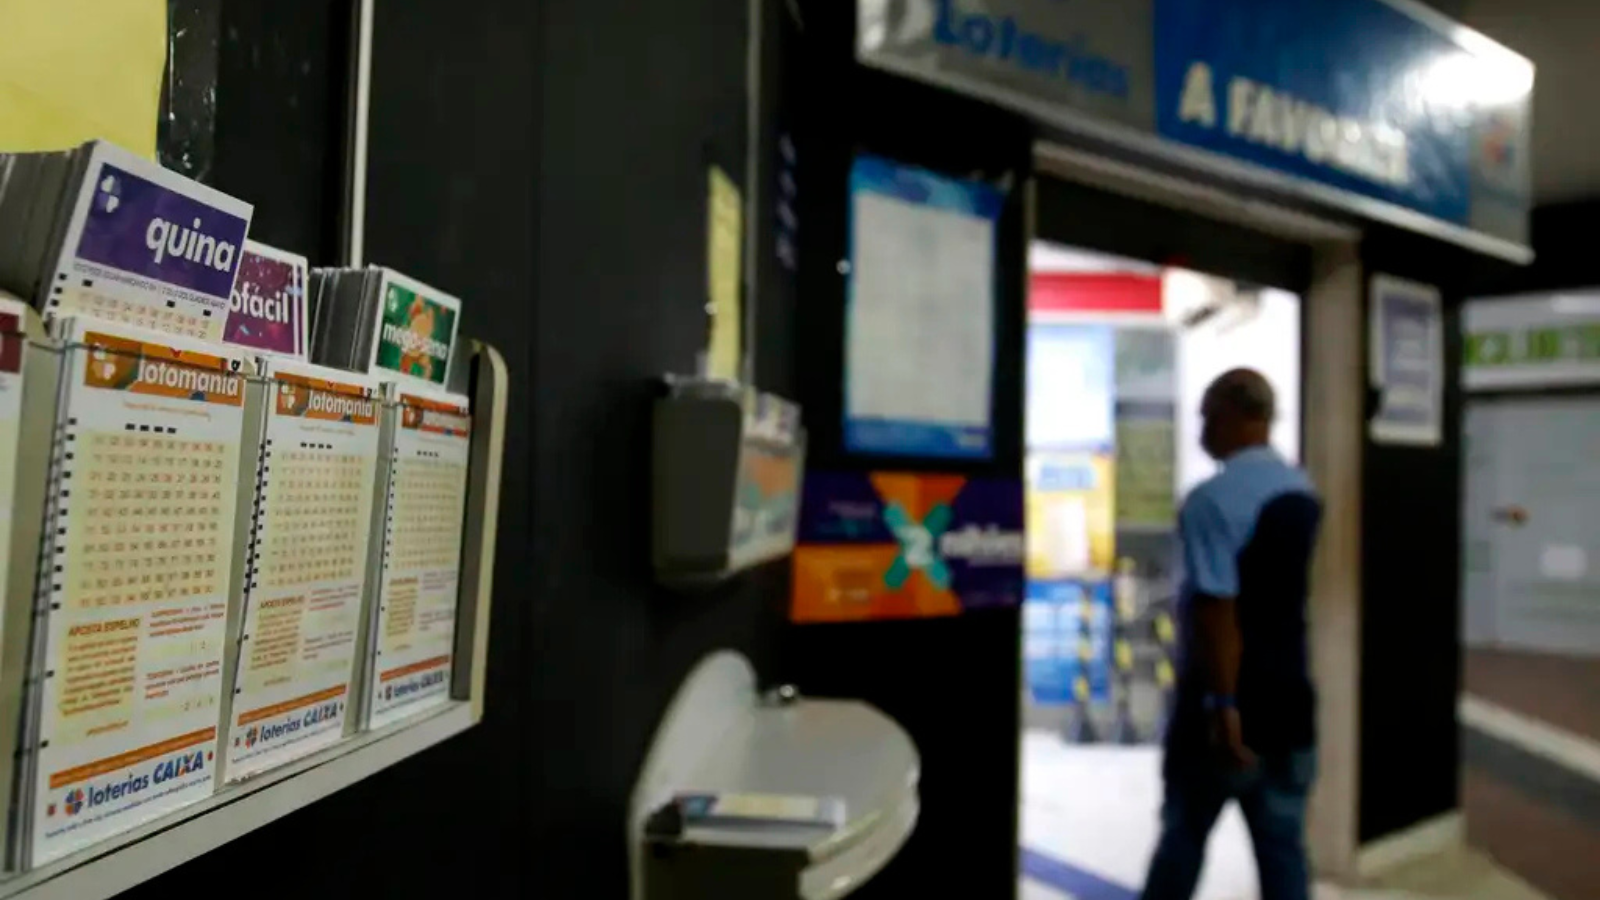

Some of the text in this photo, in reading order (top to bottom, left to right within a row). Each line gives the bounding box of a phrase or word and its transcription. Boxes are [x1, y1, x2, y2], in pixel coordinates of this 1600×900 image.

[1178, 60, 1217, 129] A
[146, 216, 236, 273] quina
[137, 356, 239, 396] lotomania
[308, 388, 373, 417] lotomania
[259, 716, 302, 743] loterias
[302, 703, 338, 729] CAIXA
[87, 771, 150, 808] loterias
[153, 750, 204, 785] CAIXA
